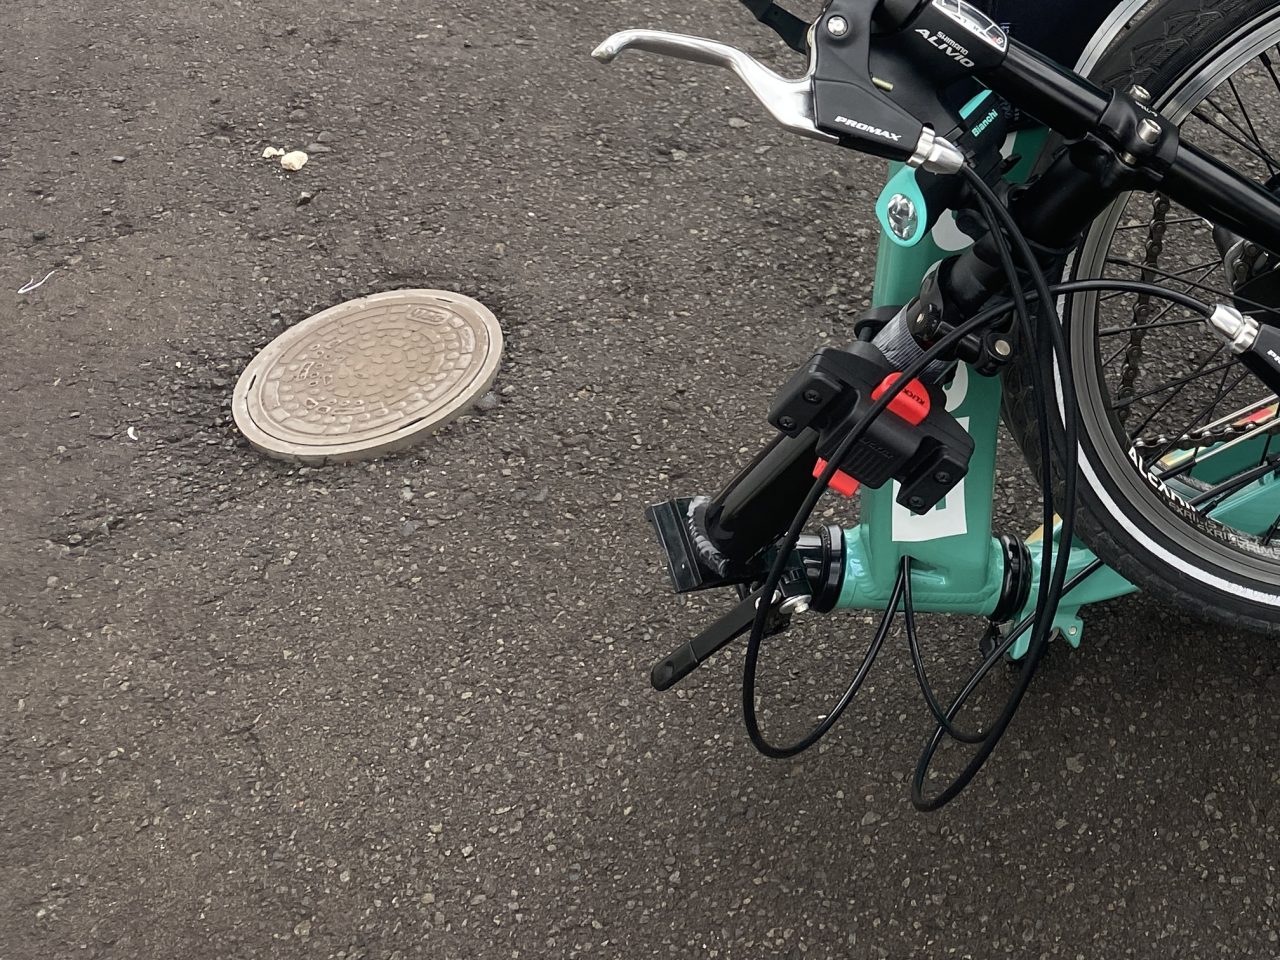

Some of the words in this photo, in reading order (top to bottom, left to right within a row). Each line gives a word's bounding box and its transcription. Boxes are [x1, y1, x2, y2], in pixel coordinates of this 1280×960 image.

[915, 29, 975, 68] ALIVIO
[936, 31, 969, 56] SHIMANO
[834, 115, 902, 141] PROMAX
[971, 109, 999, 137] Bianchi
